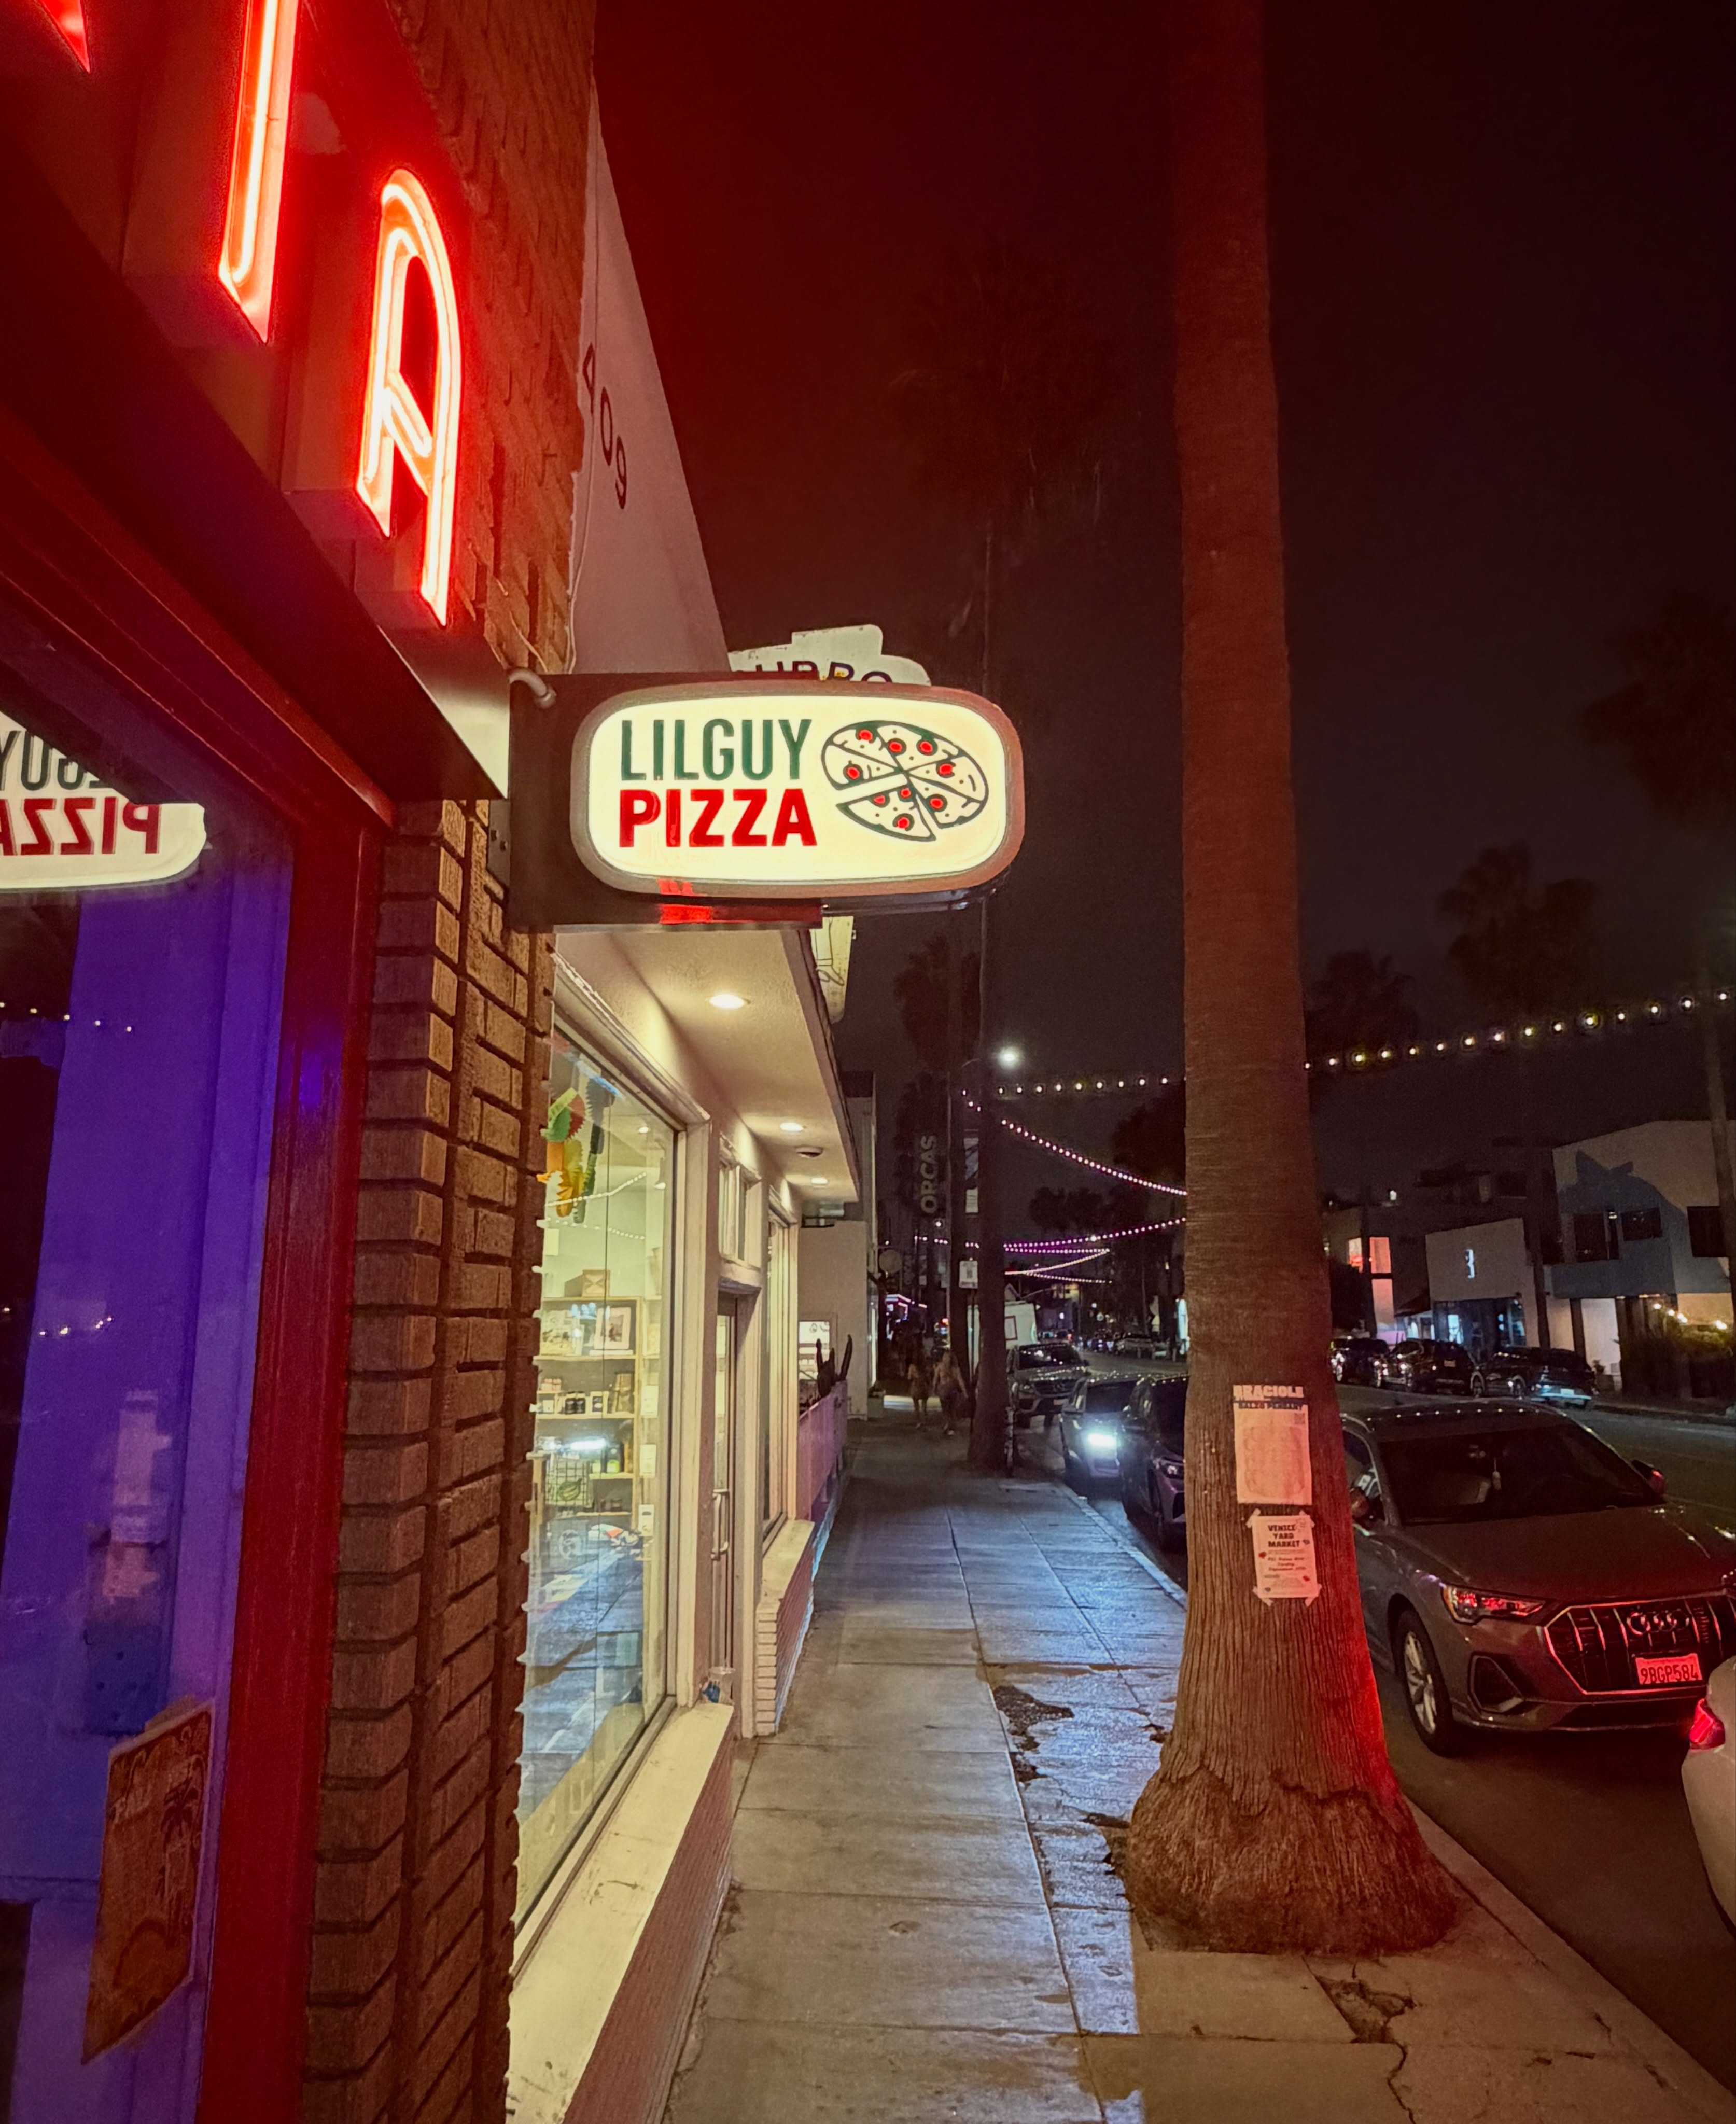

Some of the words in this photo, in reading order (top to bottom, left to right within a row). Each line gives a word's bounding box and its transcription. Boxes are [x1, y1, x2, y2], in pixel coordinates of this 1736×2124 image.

[582, 342, 627, 510] 909
[619, 788, 817, 848] PIZZA
[1268, 1540, 1300, 1548] MARKET
[1640, 1664, 1699, 1685] 9BGP584
